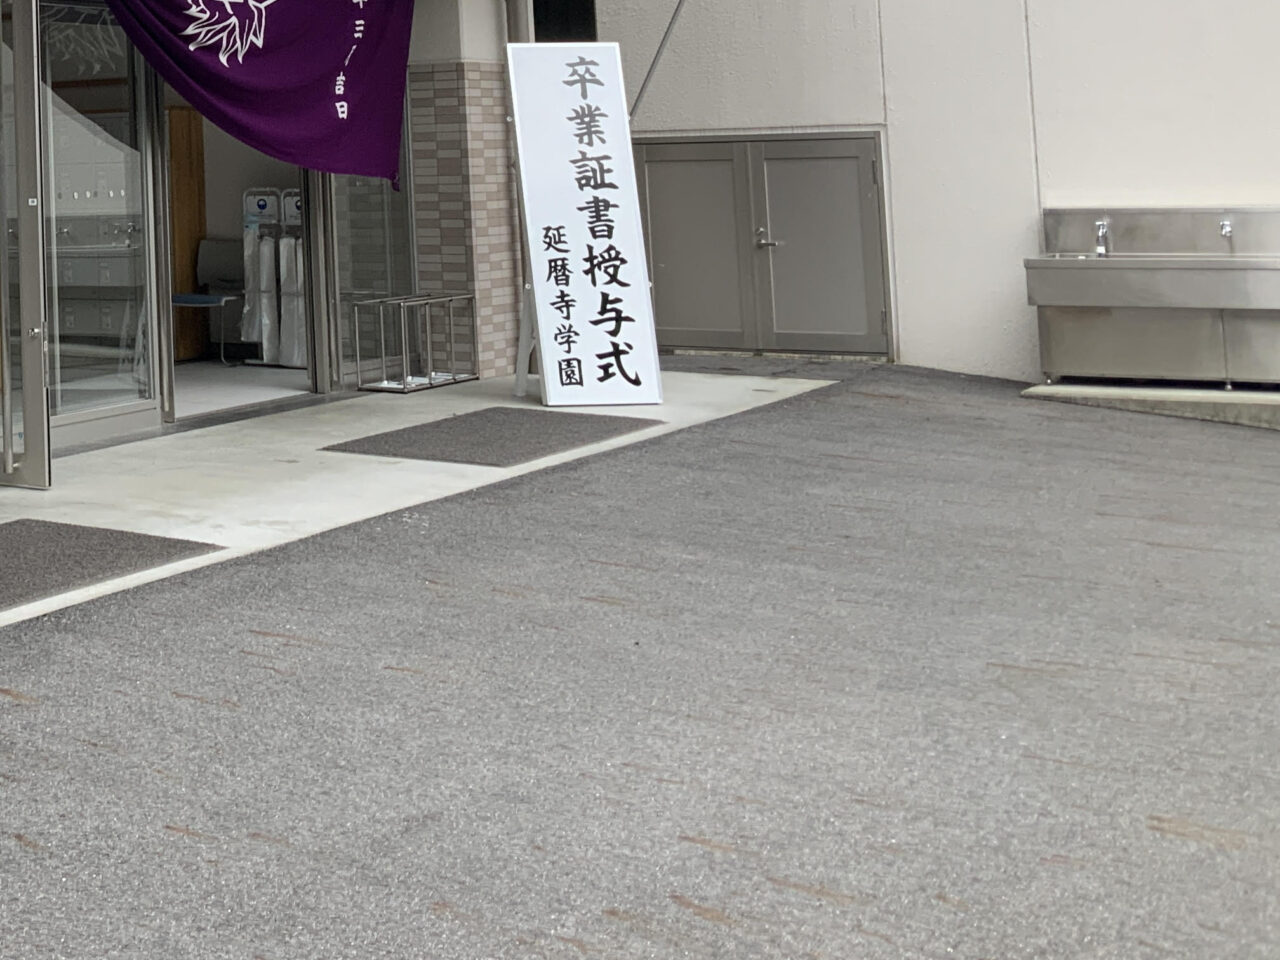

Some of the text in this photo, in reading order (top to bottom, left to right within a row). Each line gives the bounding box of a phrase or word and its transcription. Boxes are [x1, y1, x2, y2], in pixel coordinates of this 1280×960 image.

[542, 224, 584, 387] 延暦寺学園
[561, 55, 642, 387] 卒業証書授与式
